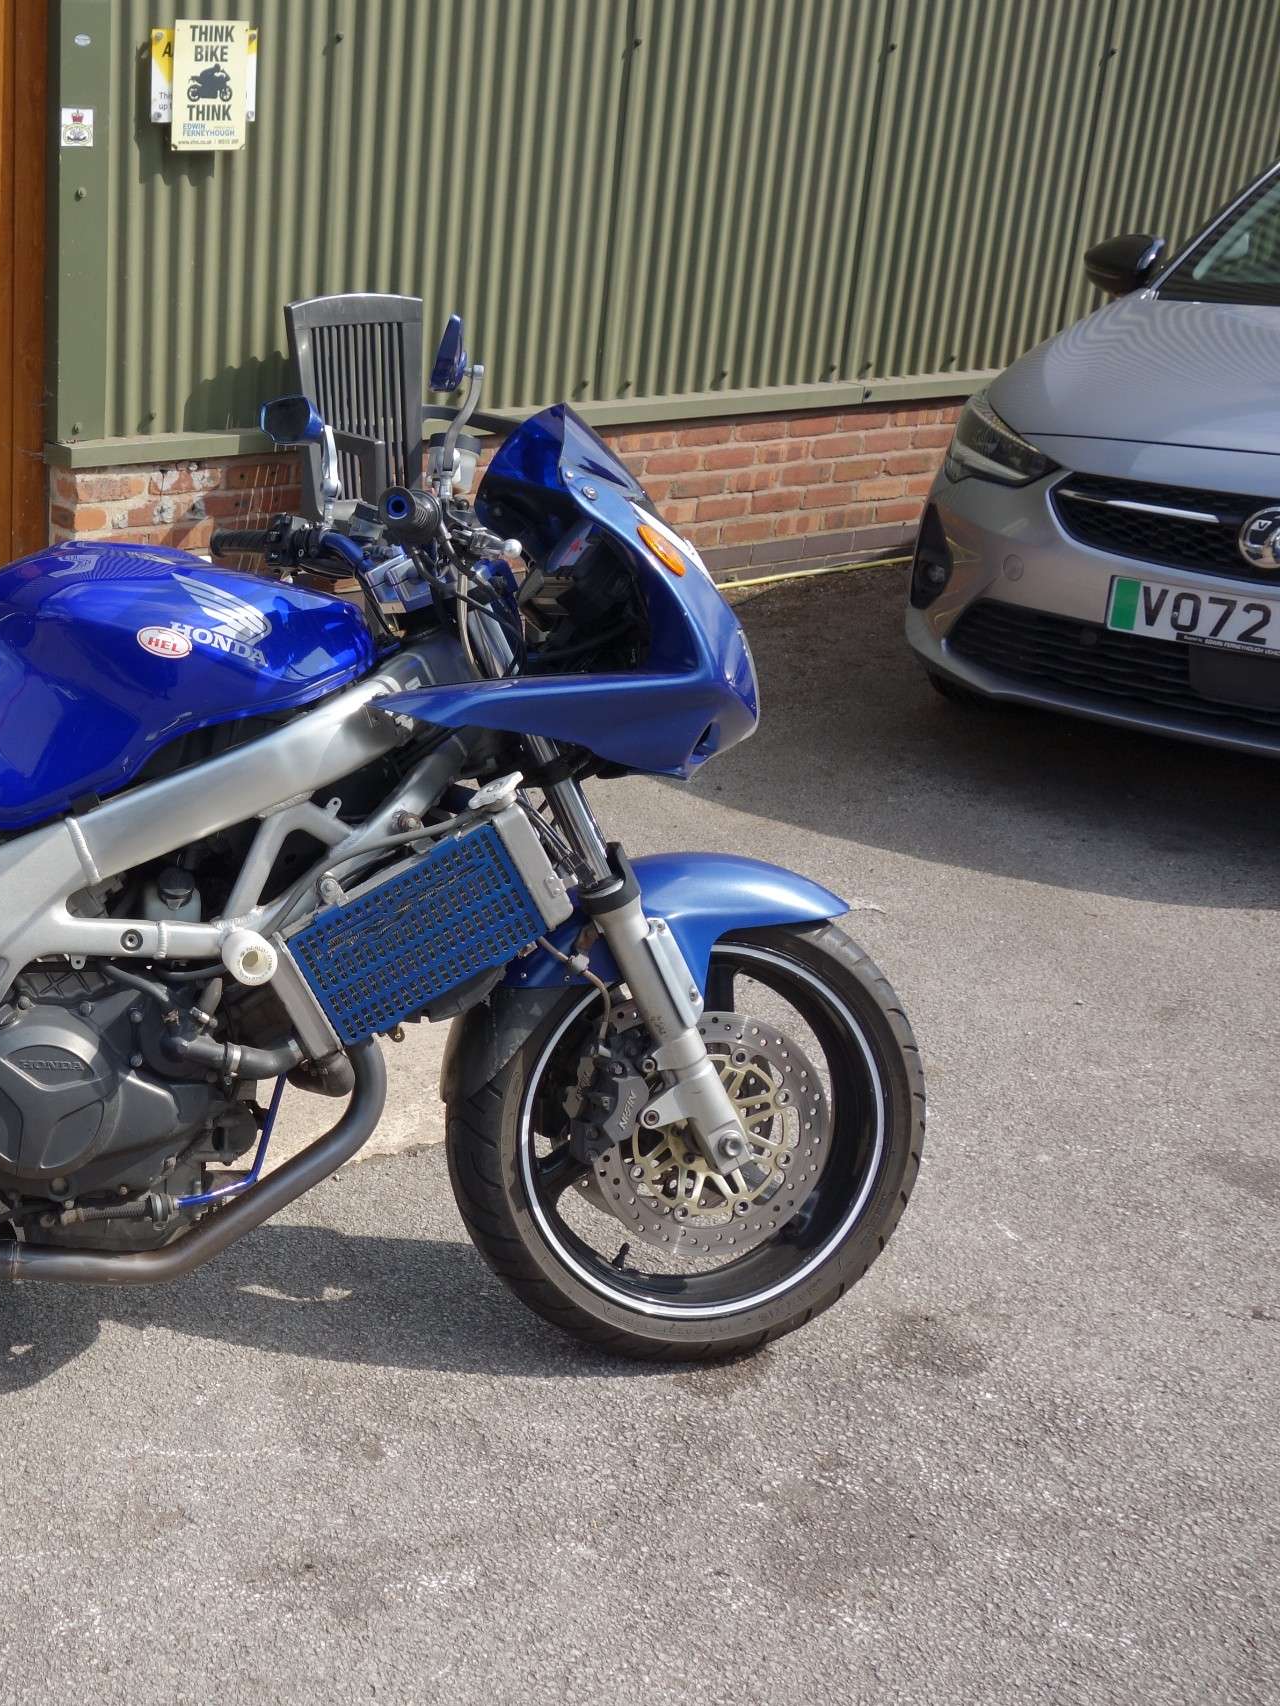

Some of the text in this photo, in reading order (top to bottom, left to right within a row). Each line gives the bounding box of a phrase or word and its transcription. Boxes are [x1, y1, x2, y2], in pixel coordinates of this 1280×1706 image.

[190, 25, 235, 42] THINK
[194, 45, 229, 62] BIKE
[187, 104, 232, 121] THINK
[1142, 585, 1272, 646] VO72
[147, 636, 181, 654] HEL
[170, 621, 269, 667] HONDA
[19, 1059, 85, 1071] HONDA
